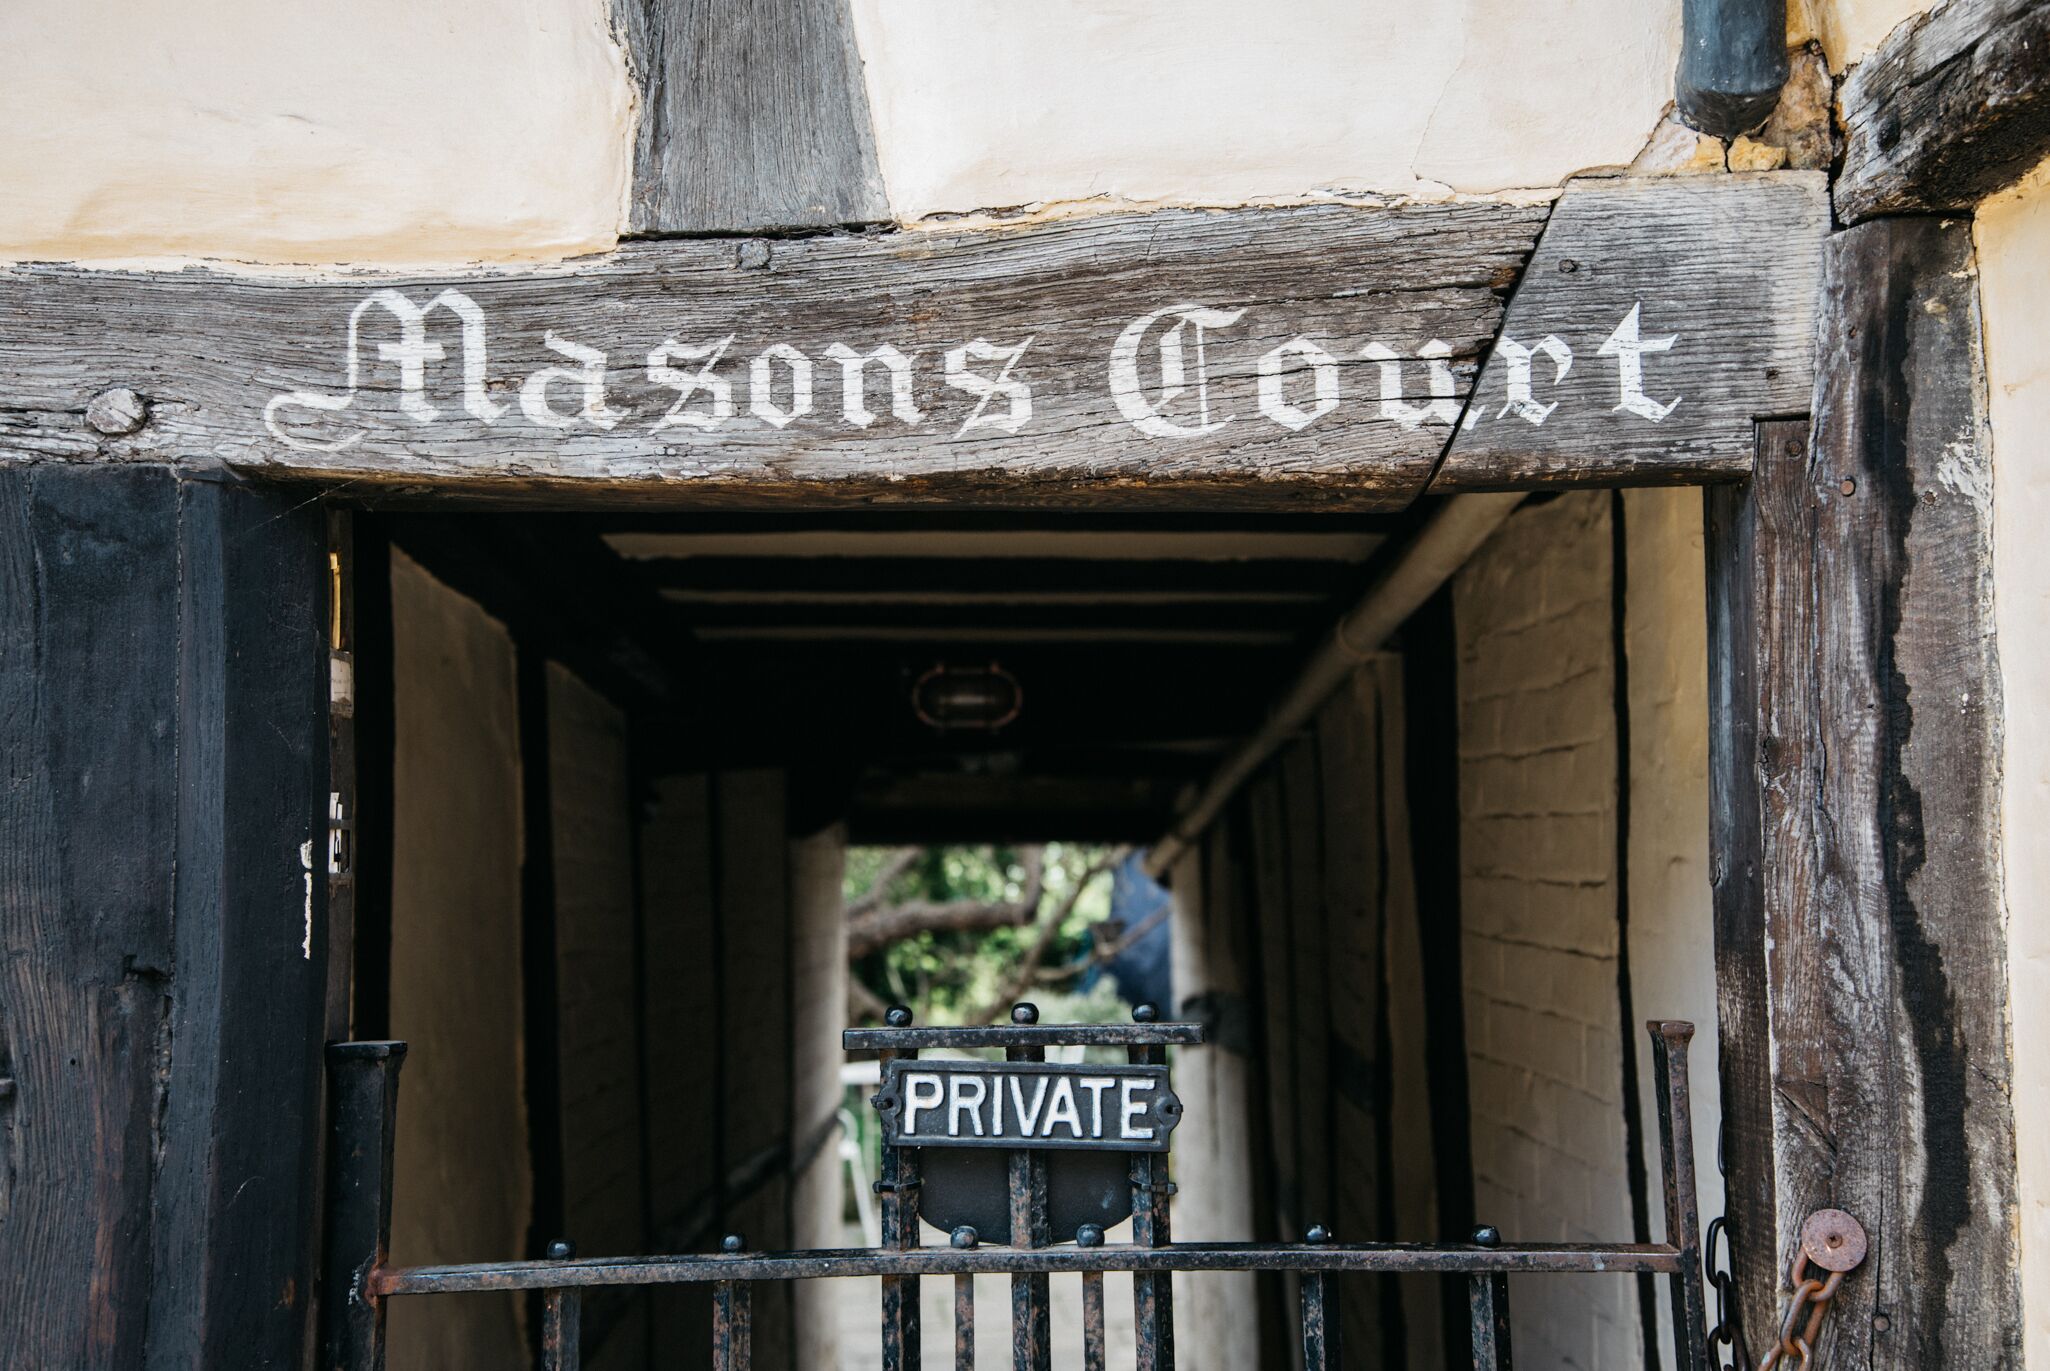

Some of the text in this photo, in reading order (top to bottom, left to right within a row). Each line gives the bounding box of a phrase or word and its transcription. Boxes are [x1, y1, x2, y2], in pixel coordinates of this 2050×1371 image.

[263, 287, 1682, 452] Masons Court
[904, 1073, 1156, 1139] PRIVATE
